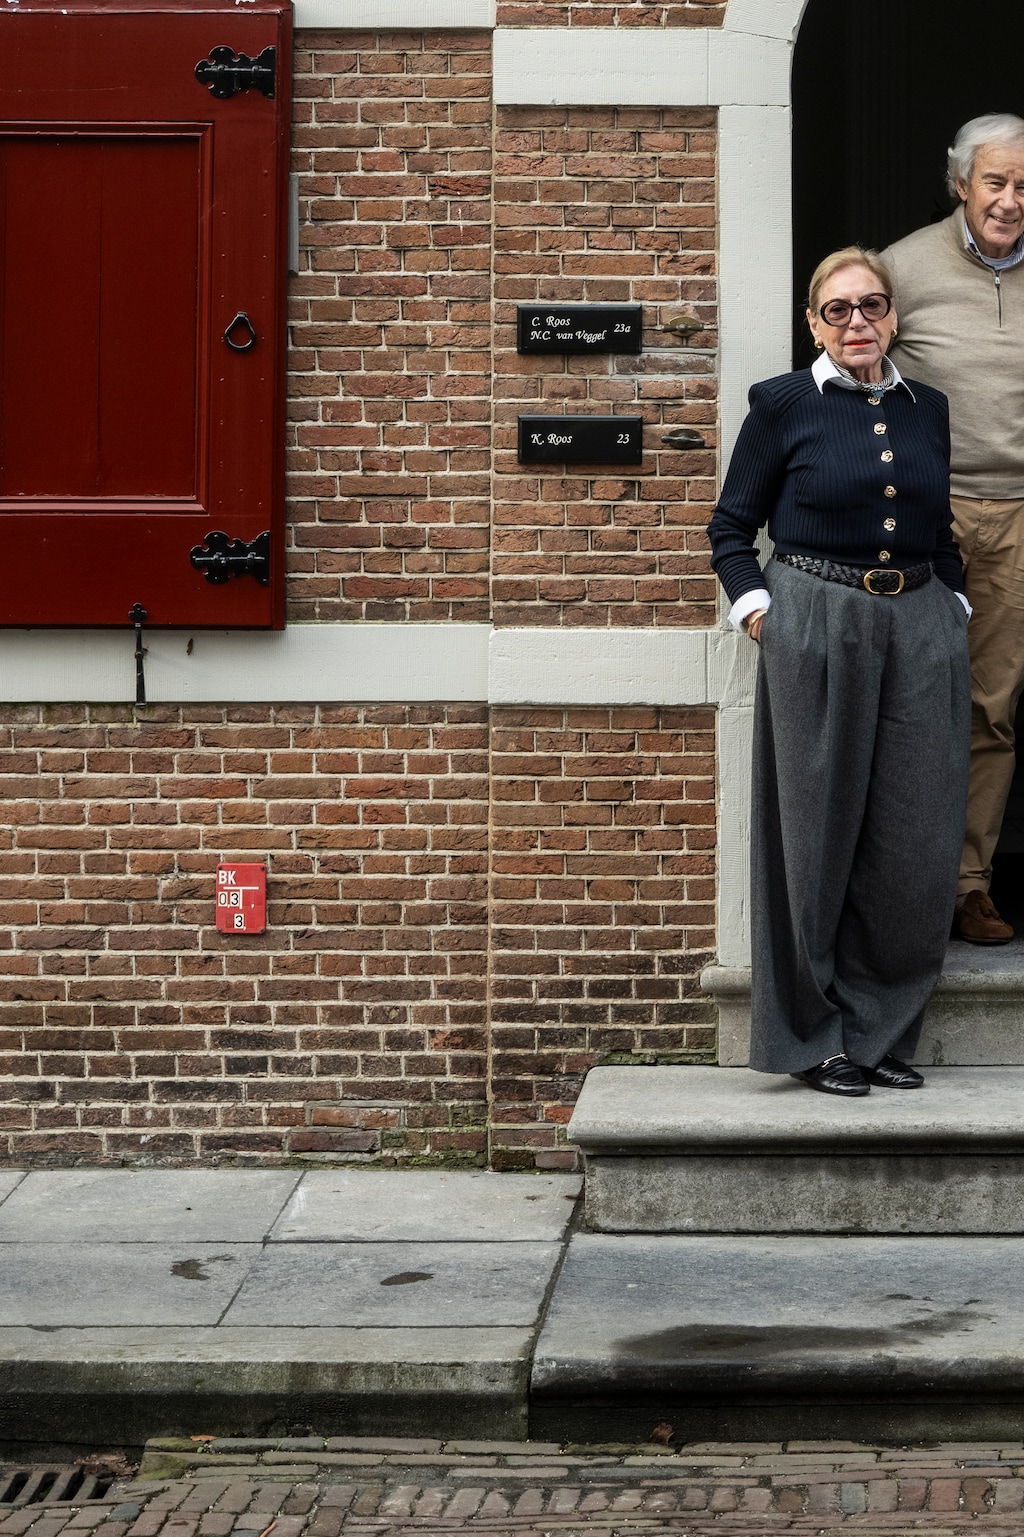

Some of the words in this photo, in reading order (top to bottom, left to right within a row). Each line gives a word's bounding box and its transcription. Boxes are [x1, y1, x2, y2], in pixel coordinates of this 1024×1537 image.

[531, 316, 541, 327] C.
[545, 315, 571, 328] Roos
[613, 323, 632, 333] 23a
[530, 330, 551, 341] N.C.
[555, 332, 574, 340] van
[575, 329, 608, 344] Veggel
[530, 433, 545, 445] K.
[546, 432, 573, 446] Roos
[616, 433, 630, 445] 23
[218, 870, 237, 885] BK
